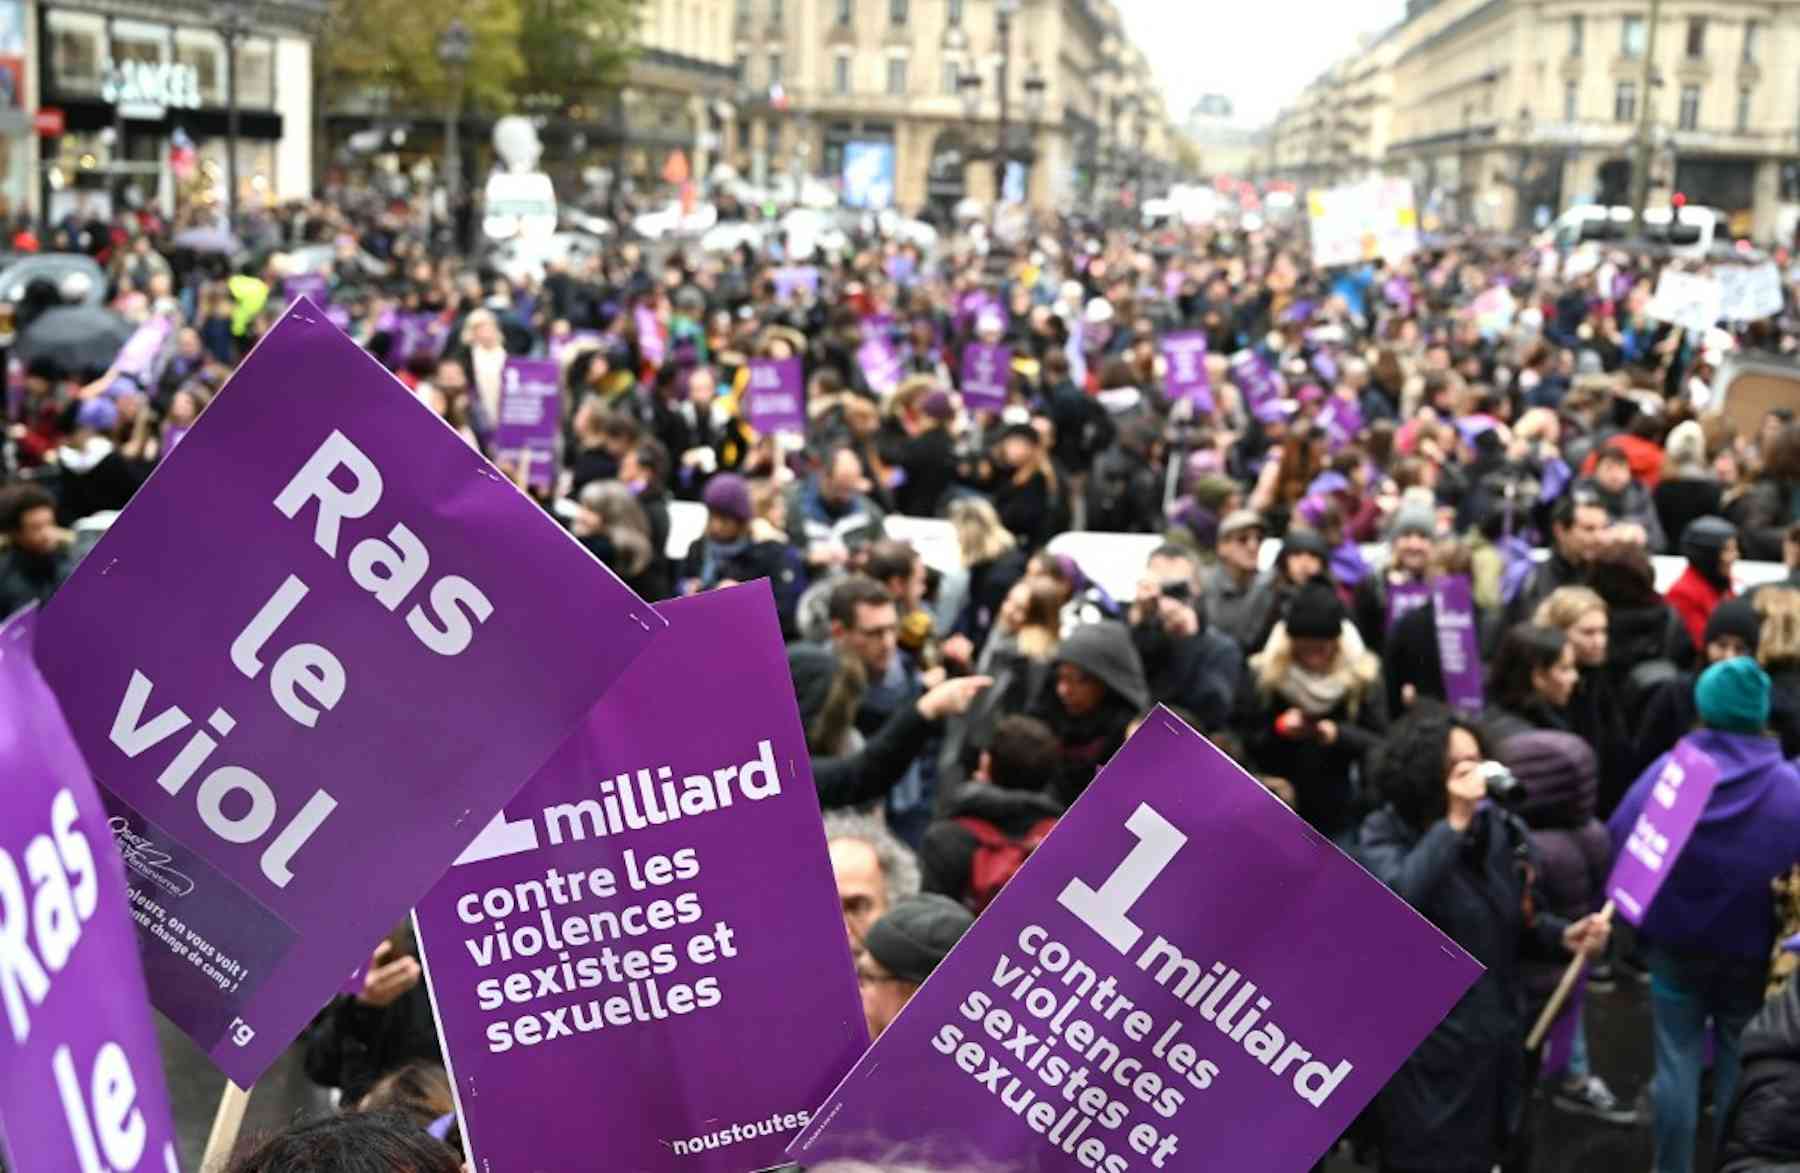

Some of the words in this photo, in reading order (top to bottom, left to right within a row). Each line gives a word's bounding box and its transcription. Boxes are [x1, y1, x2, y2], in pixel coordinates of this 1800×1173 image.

[272, 428, 495, 657] Ras
[230, 573, 347, 729] le
[108, 668, 339, 889] viol
[543, 739, 781, 845] milliard
[0, 787, 98, 1044] Ras
[127, 887, 167, 922] oleurs,
[168, 917, 186, 934] on
[186, 929, 215, 957] vous
[215, 952, 240, 977] voit
[238, 969, 249, 982] !
[456, 864, 617, 925] contre
[623, 847, 701, 892] les
[465, 891, 703, 967] violences
[1056, 800, 1188, 956] 1
[150, 923, 189, 956] change
[187, 951, 204, 967] de
[202, 963, 231, 990] camp
[476, 942, 679, 1011] sexistes
[686, 920, 738, 965] et
[486, 975, 723, 1054] sexuelles
[1018, 924, 1154, 1042] contre
[1151, 1020, 1221, 1090] les
[1135, 934, 1354, 1109] milliard
[52, 1040, 148, 1173] le
[930, 1023, 1130, 1173] sexuelles
[959, 990, 1131, 1130] sexistes
[1127, 1121, 1180, 1170] et
[991, 953, 1186, 1119] violences
[672, 1109, 811, 1155] noustoutes
